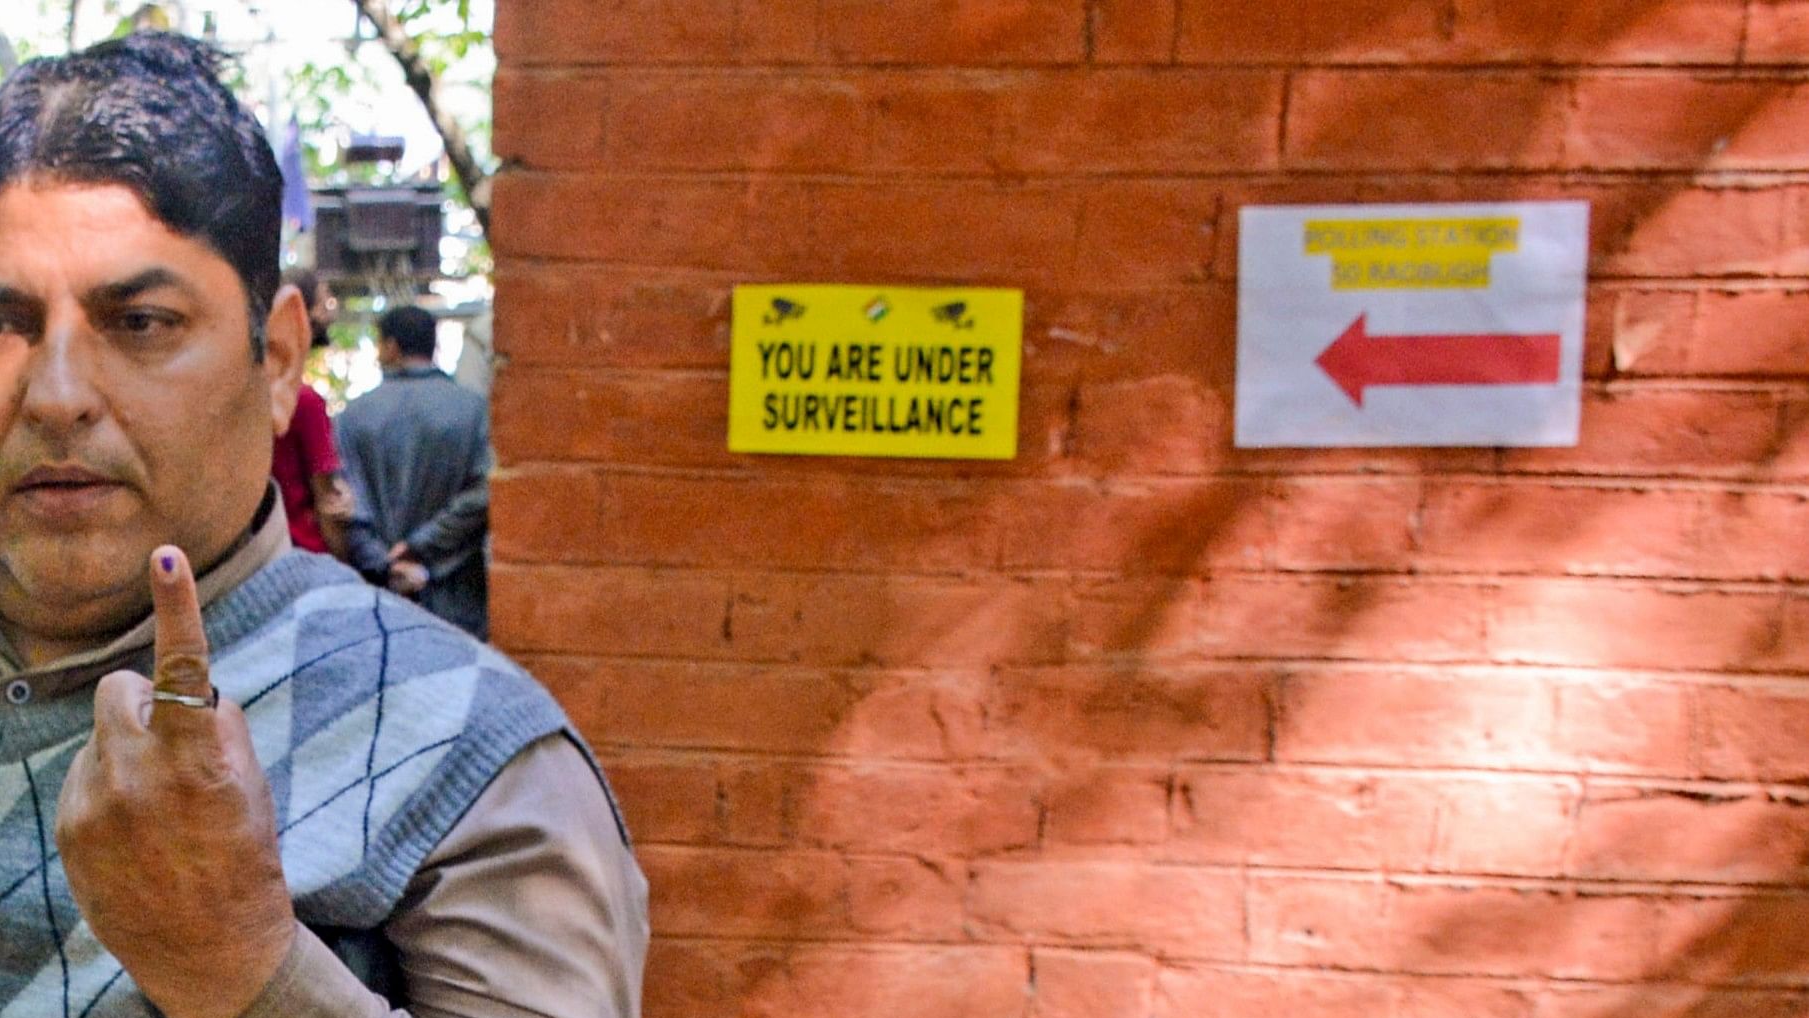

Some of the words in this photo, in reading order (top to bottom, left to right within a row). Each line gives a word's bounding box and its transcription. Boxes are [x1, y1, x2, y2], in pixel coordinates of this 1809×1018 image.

[1305, 227, 1407, 249] POLLING
[1417, 225, 1519, 246] STATION
[758, 342, 816, 381] YOU
[826, 343, 883, 382] ARE
[895, 346, 995, 384] UNDER
[763, 393, 983, 436] SURVEILLANCE
